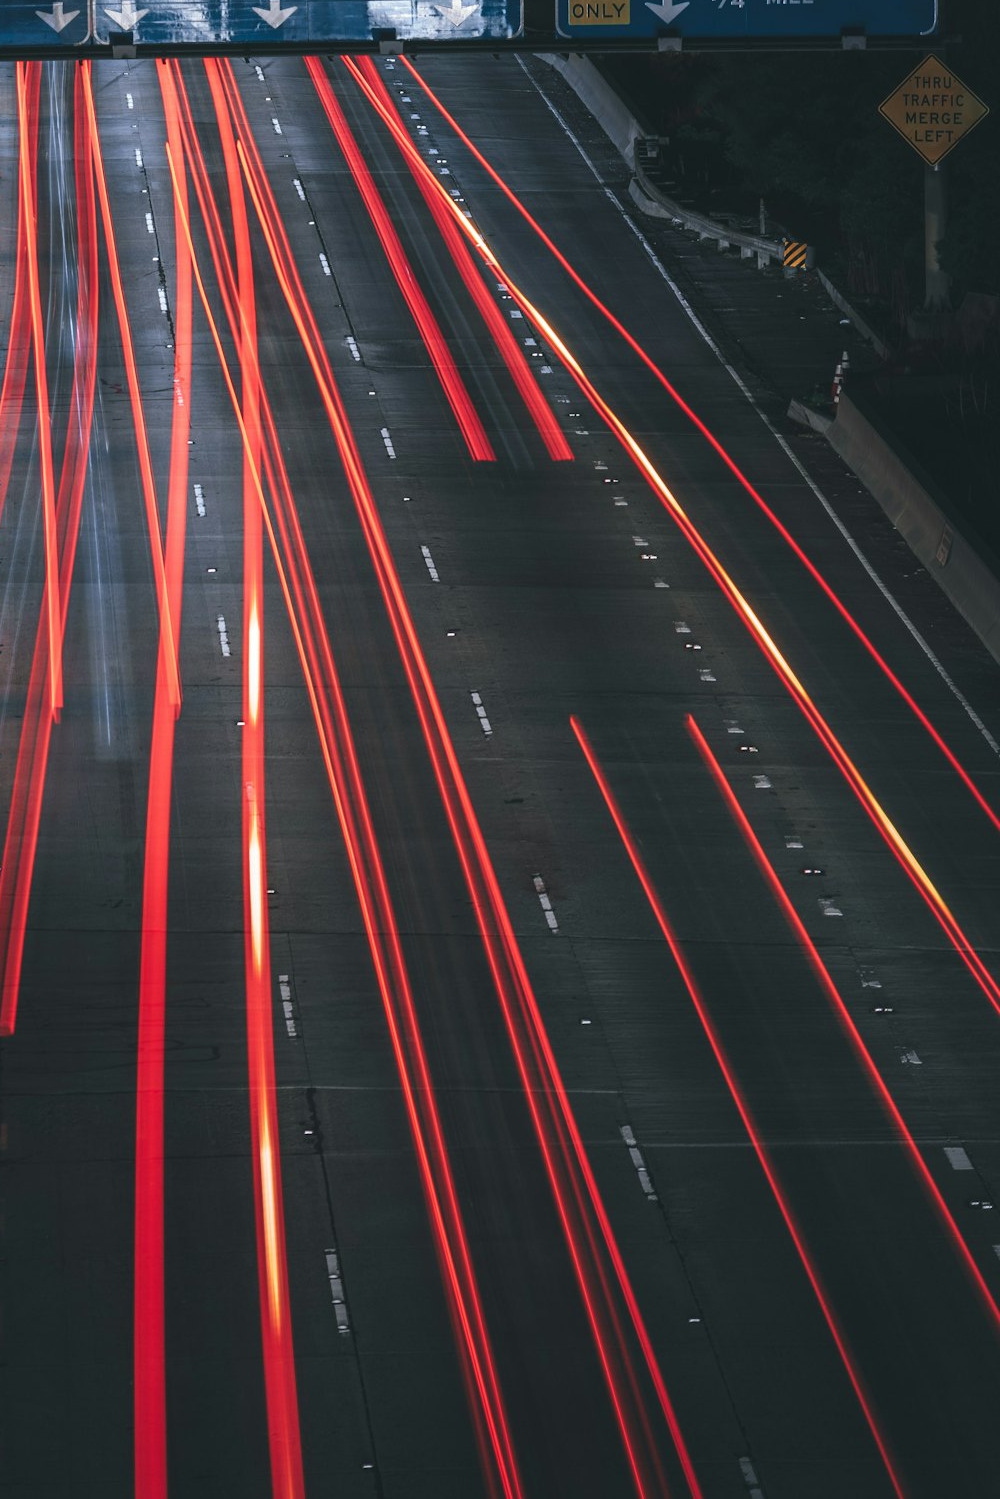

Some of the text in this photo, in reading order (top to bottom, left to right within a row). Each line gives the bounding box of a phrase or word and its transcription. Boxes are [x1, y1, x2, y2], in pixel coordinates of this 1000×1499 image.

[572, 2, 626, 19] ONLY
[914, 76, 952, 89] THRU
[903, 94, 964, 107] TRAFFIC
[905, 112, 963, 125] MERGE
[914, 129, 954, 142] LEFT
